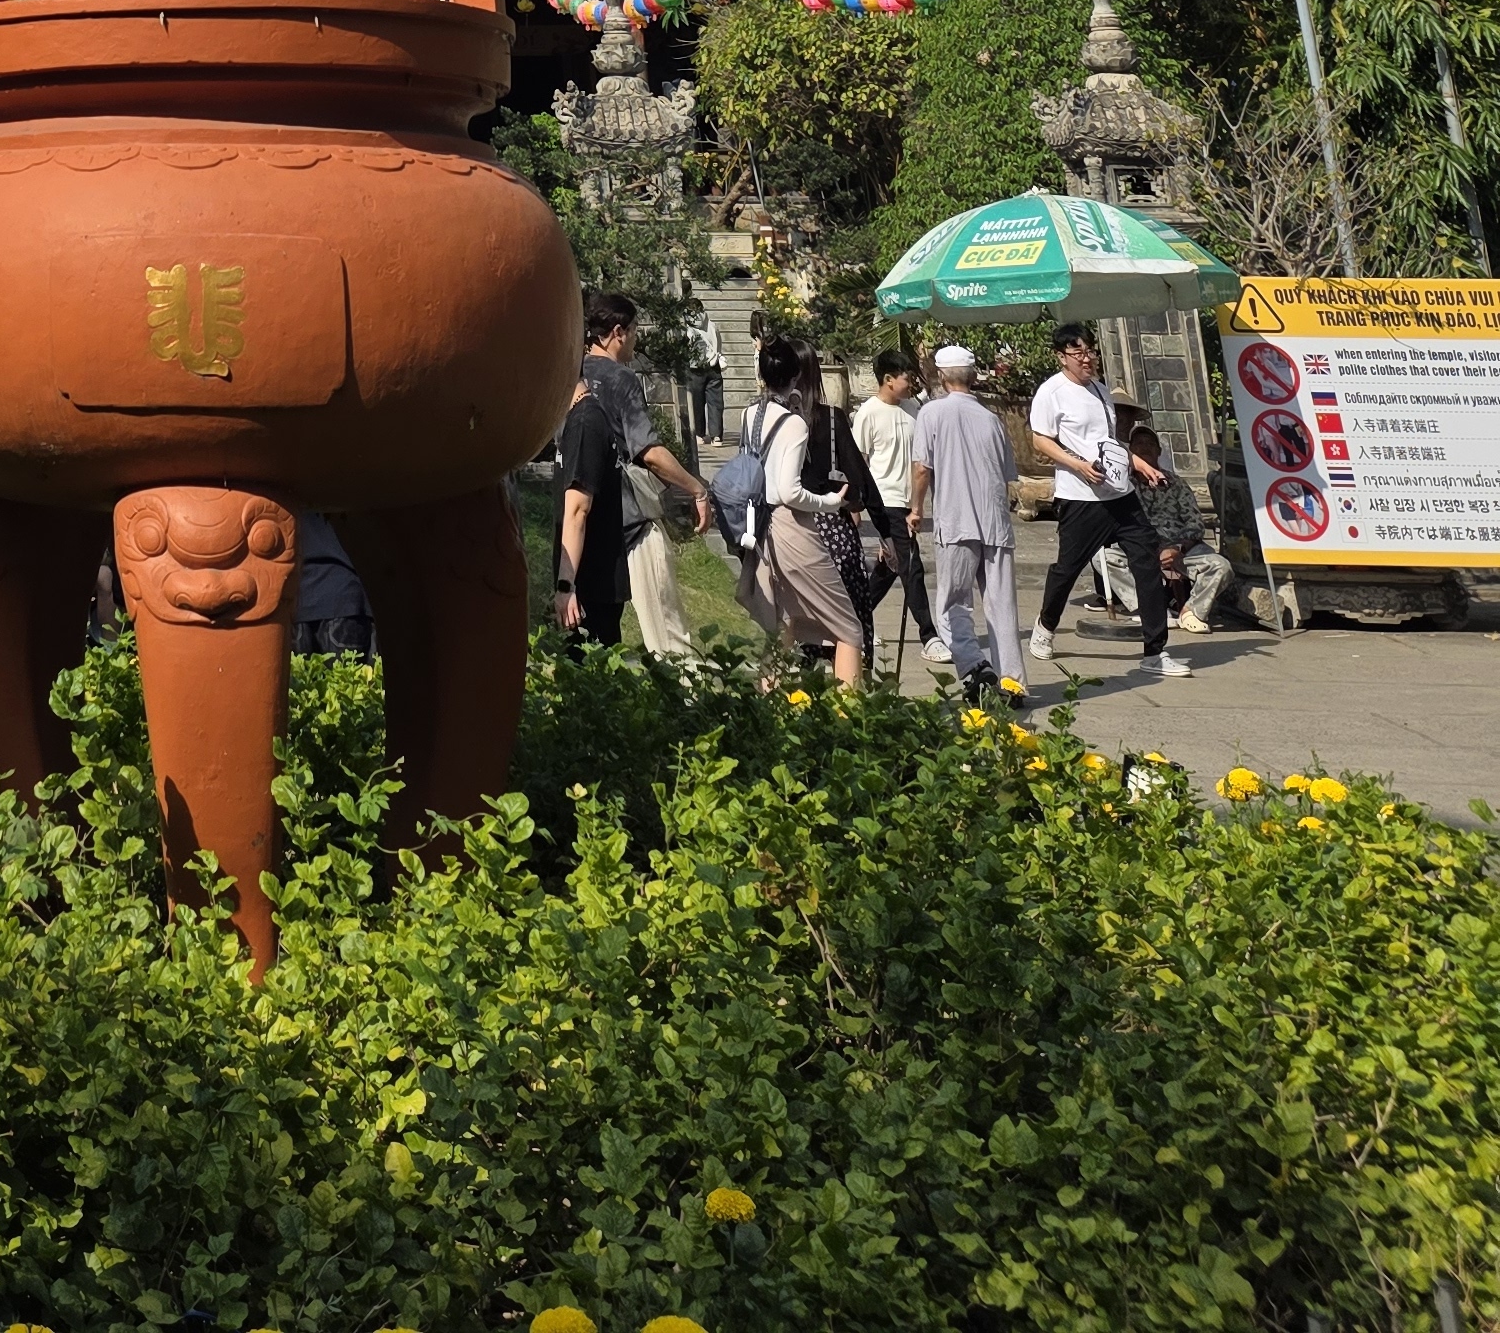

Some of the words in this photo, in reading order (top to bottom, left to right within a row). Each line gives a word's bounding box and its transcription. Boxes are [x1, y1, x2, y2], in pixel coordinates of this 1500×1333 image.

[964, 248, 1004, 266] CỰC
[1005, 243, 1040, 261] ĐÃ!
[946, 283, 988, 301] Sprite
[1390, 287, 1421, 305] VÀO
[1425, 287, 1466, 306] CHÙA
[1468, 290, 1494, 306] VUI
[1316, 311, 1367, 326] TRANG
[1370, 311, 1411, 331] PHỤC
[1445, 309, 1481, 330] ĐÁO,
[1483, 313, 1500, 332] LỊ
[1334, 348, 1363, 360] when
[1365, 348, 1407, 362] entering
[1409, 349, 1426, 361] the
[1428, 349, 1468, 362] temple,
[1338, 364, 1367, 376] polite
[1370, 364, 1408, 376] clothes
[1409, 365, 1430, 376] that
[1432, 366, 1460, 377] cover
[1462, 365, 1487, 377] their
[1488, 366, 1500, 377] le
[1344, 391, 1408, 406] Соблюдайте
[1410, 393, 1462, 407] скромный
[1462, 396, 1470, 406] и
[1352, 418, 1441, 434] 入寺请着装端庄
[1369, 498, 1390, 512] 사찰
[1393, 498, 1416, 513] 입장
[1420, 499, 1431, 513] 시
[1432, 498, 1466, 513] 단정한
[1467, 499, 1490, 514] 복장
